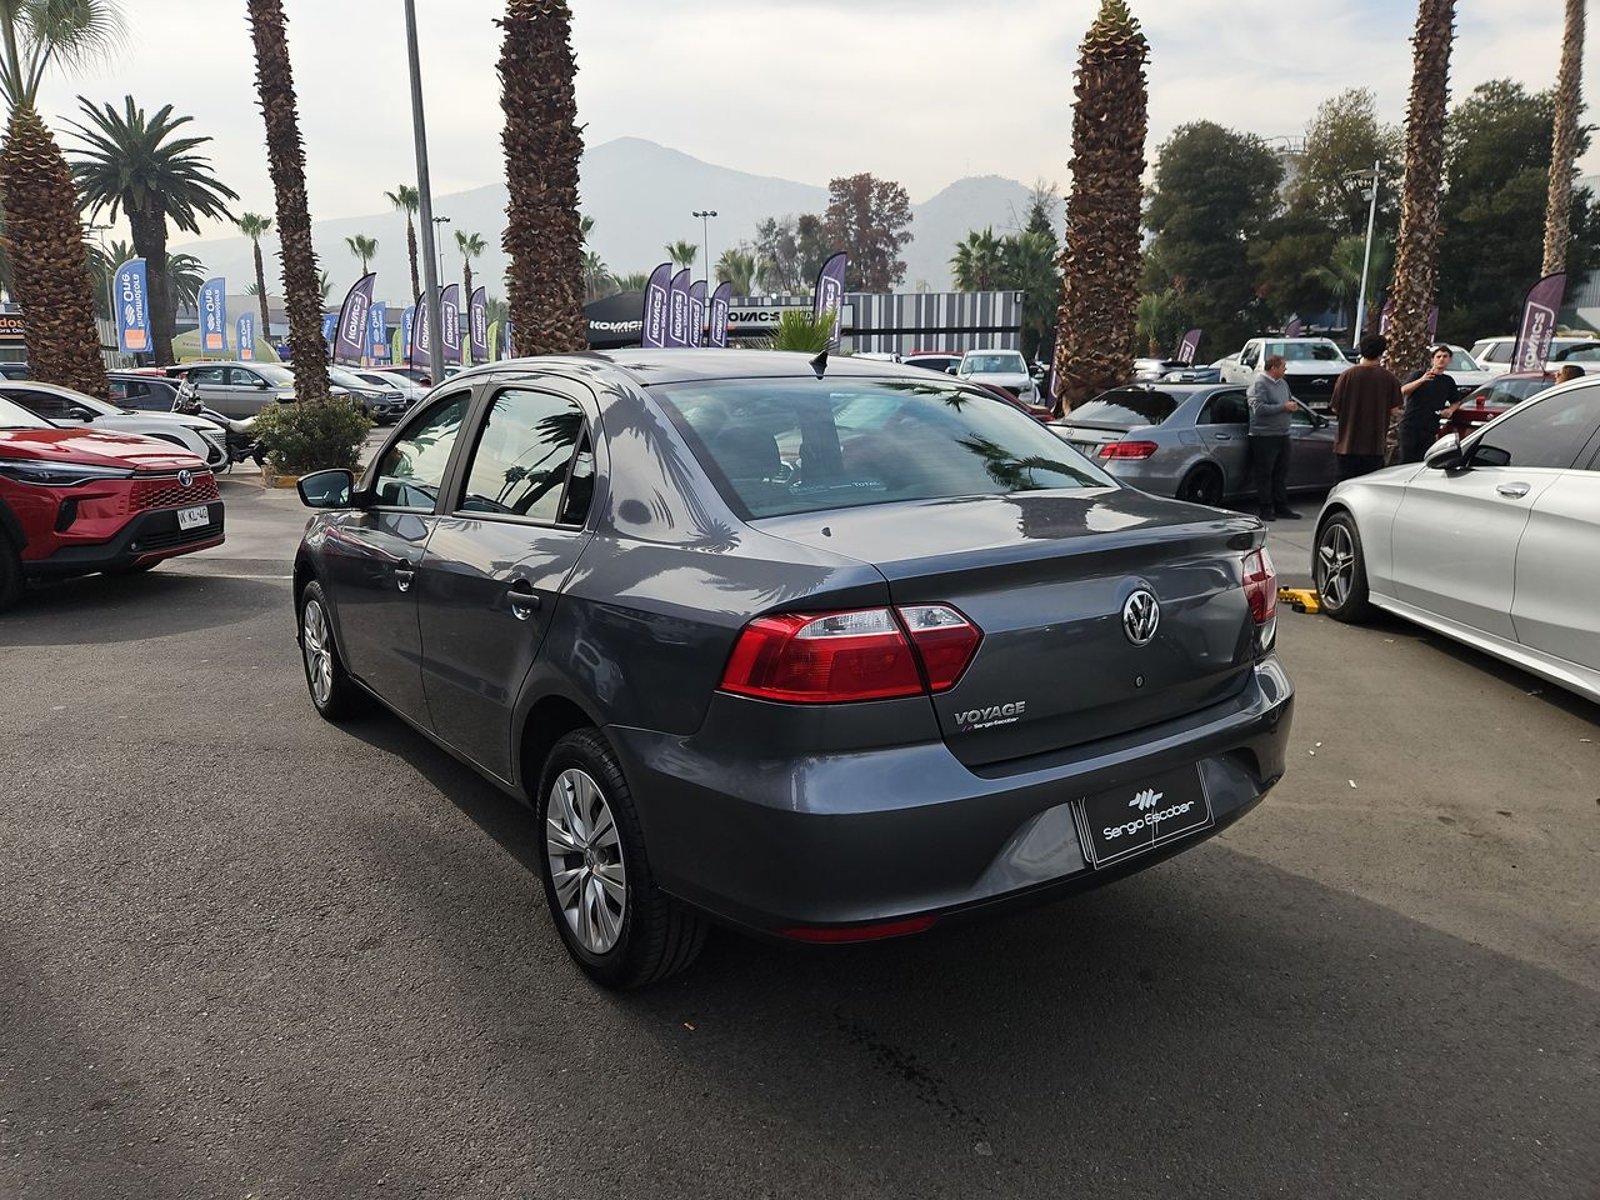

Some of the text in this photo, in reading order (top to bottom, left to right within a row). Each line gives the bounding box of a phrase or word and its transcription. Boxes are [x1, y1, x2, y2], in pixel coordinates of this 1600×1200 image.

[446, 306, 454, 343] KOVACS
[652, 291, 662, 339] KOVACS
[674, 294, 683, 337] KOVACS
[728, 312, 780, 322] OVACS
[954, 701, 1026, 725] VOYAGE
[1103, 801, 1194, 840] Sergo Escobar
